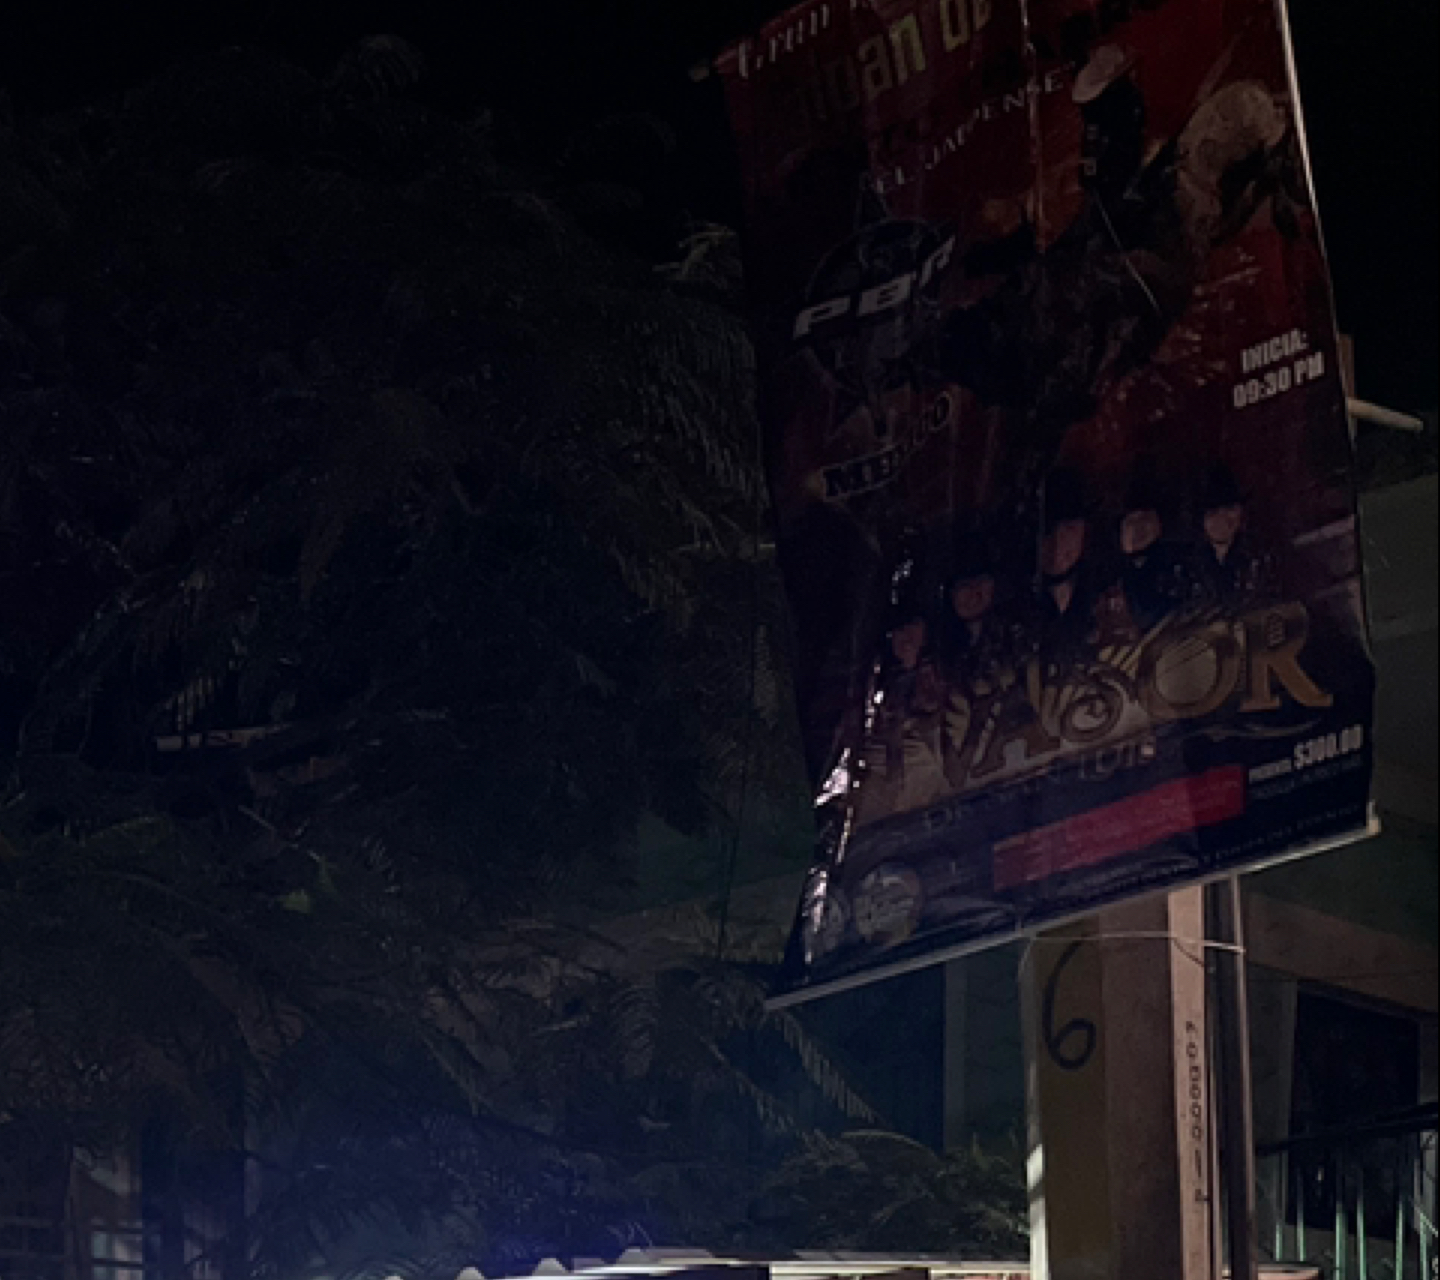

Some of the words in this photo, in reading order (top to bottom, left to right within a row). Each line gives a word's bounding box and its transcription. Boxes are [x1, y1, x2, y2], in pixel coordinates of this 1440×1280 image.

[1242, 328, 1308, 374] INICIA:
[1233, 366, 1292, 411] 09:30
[1293, 350, 1325, 387] PM
